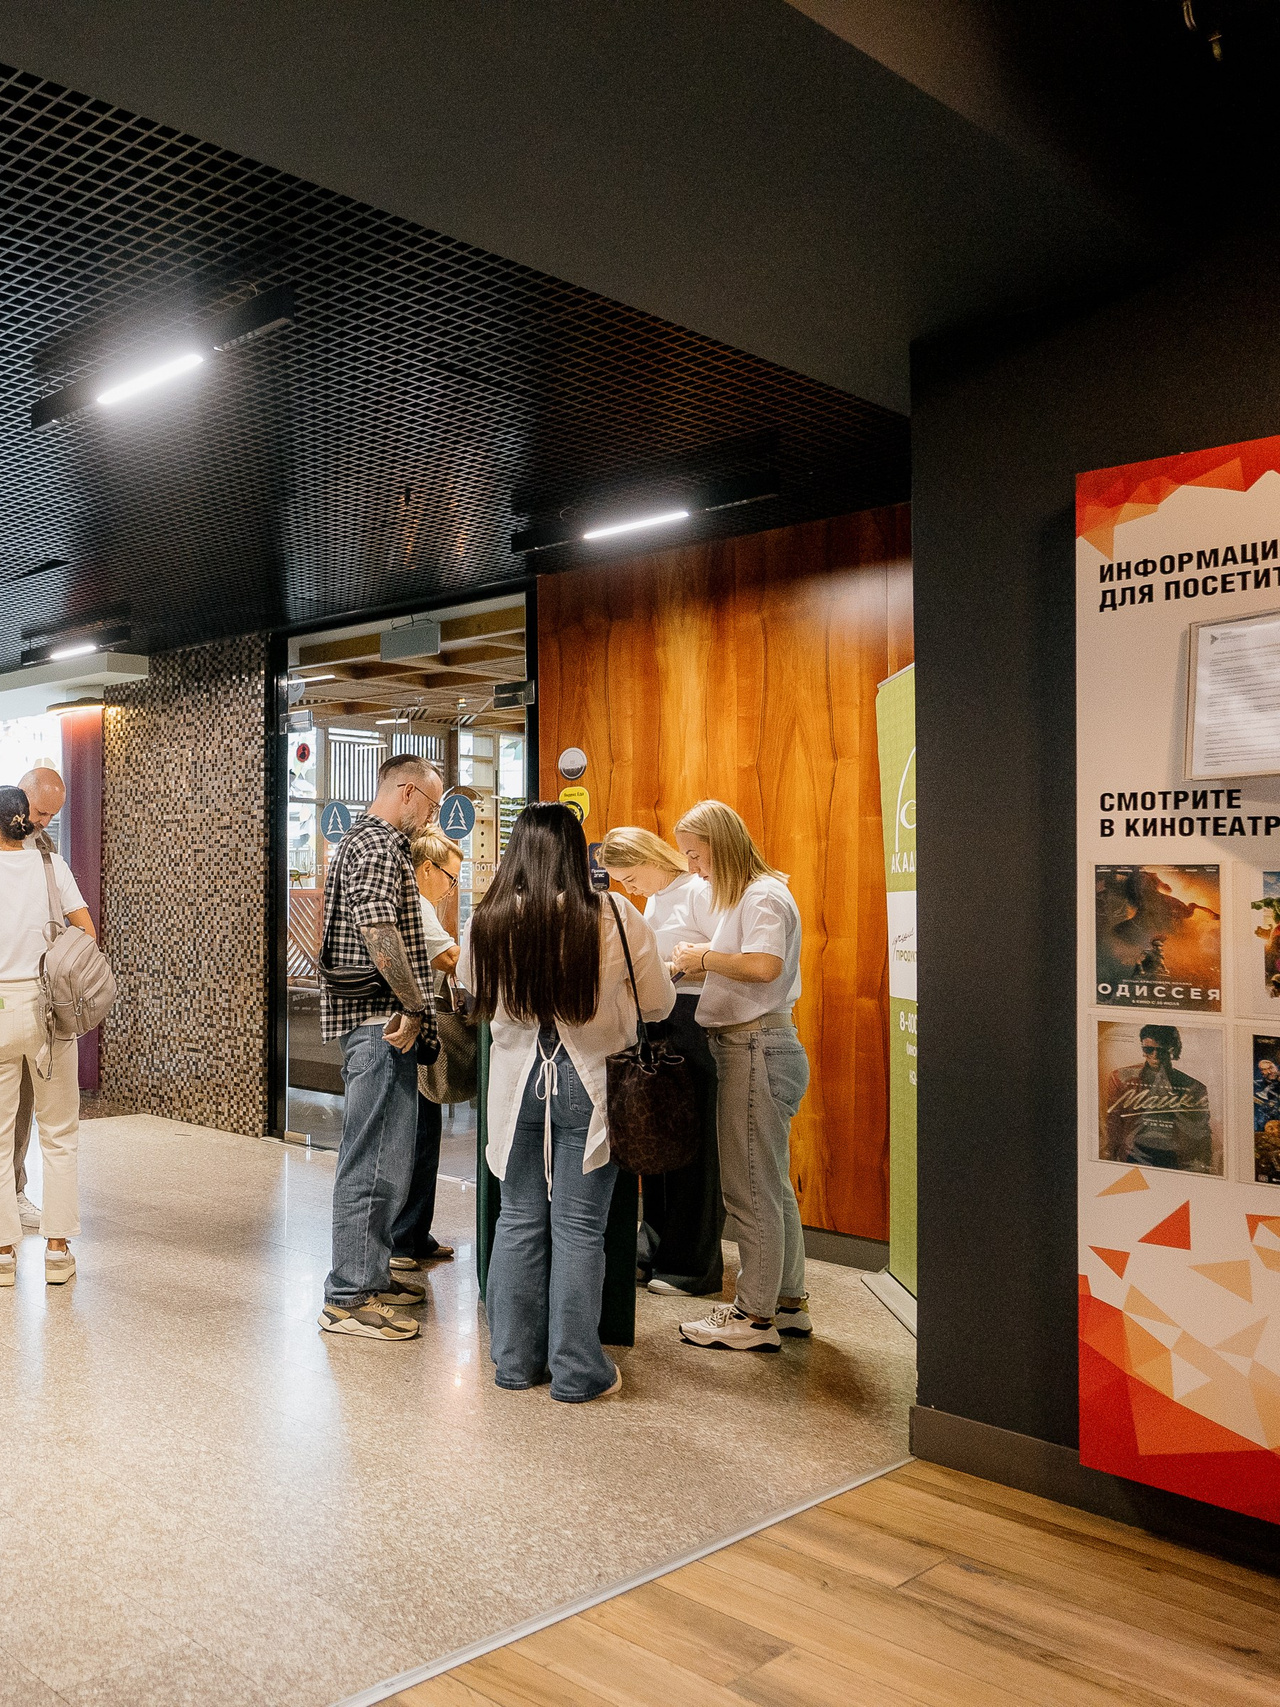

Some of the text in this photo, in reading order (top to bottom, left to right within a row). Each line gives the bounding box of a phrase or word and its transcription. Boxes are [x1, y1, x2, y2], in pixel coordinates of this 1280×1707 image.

[1099, 539, 1278, 583] ИНФОРМАЦИ
[1099, 584, 1154, 612] ДЛЯ
[1100, 789, 1242, 812] СМОТРИТЕ
[1100, 815, 1280, 838] В КИНОТЕАТР
[1097, 982, 1220, 1000] ОДИССЕЯ
